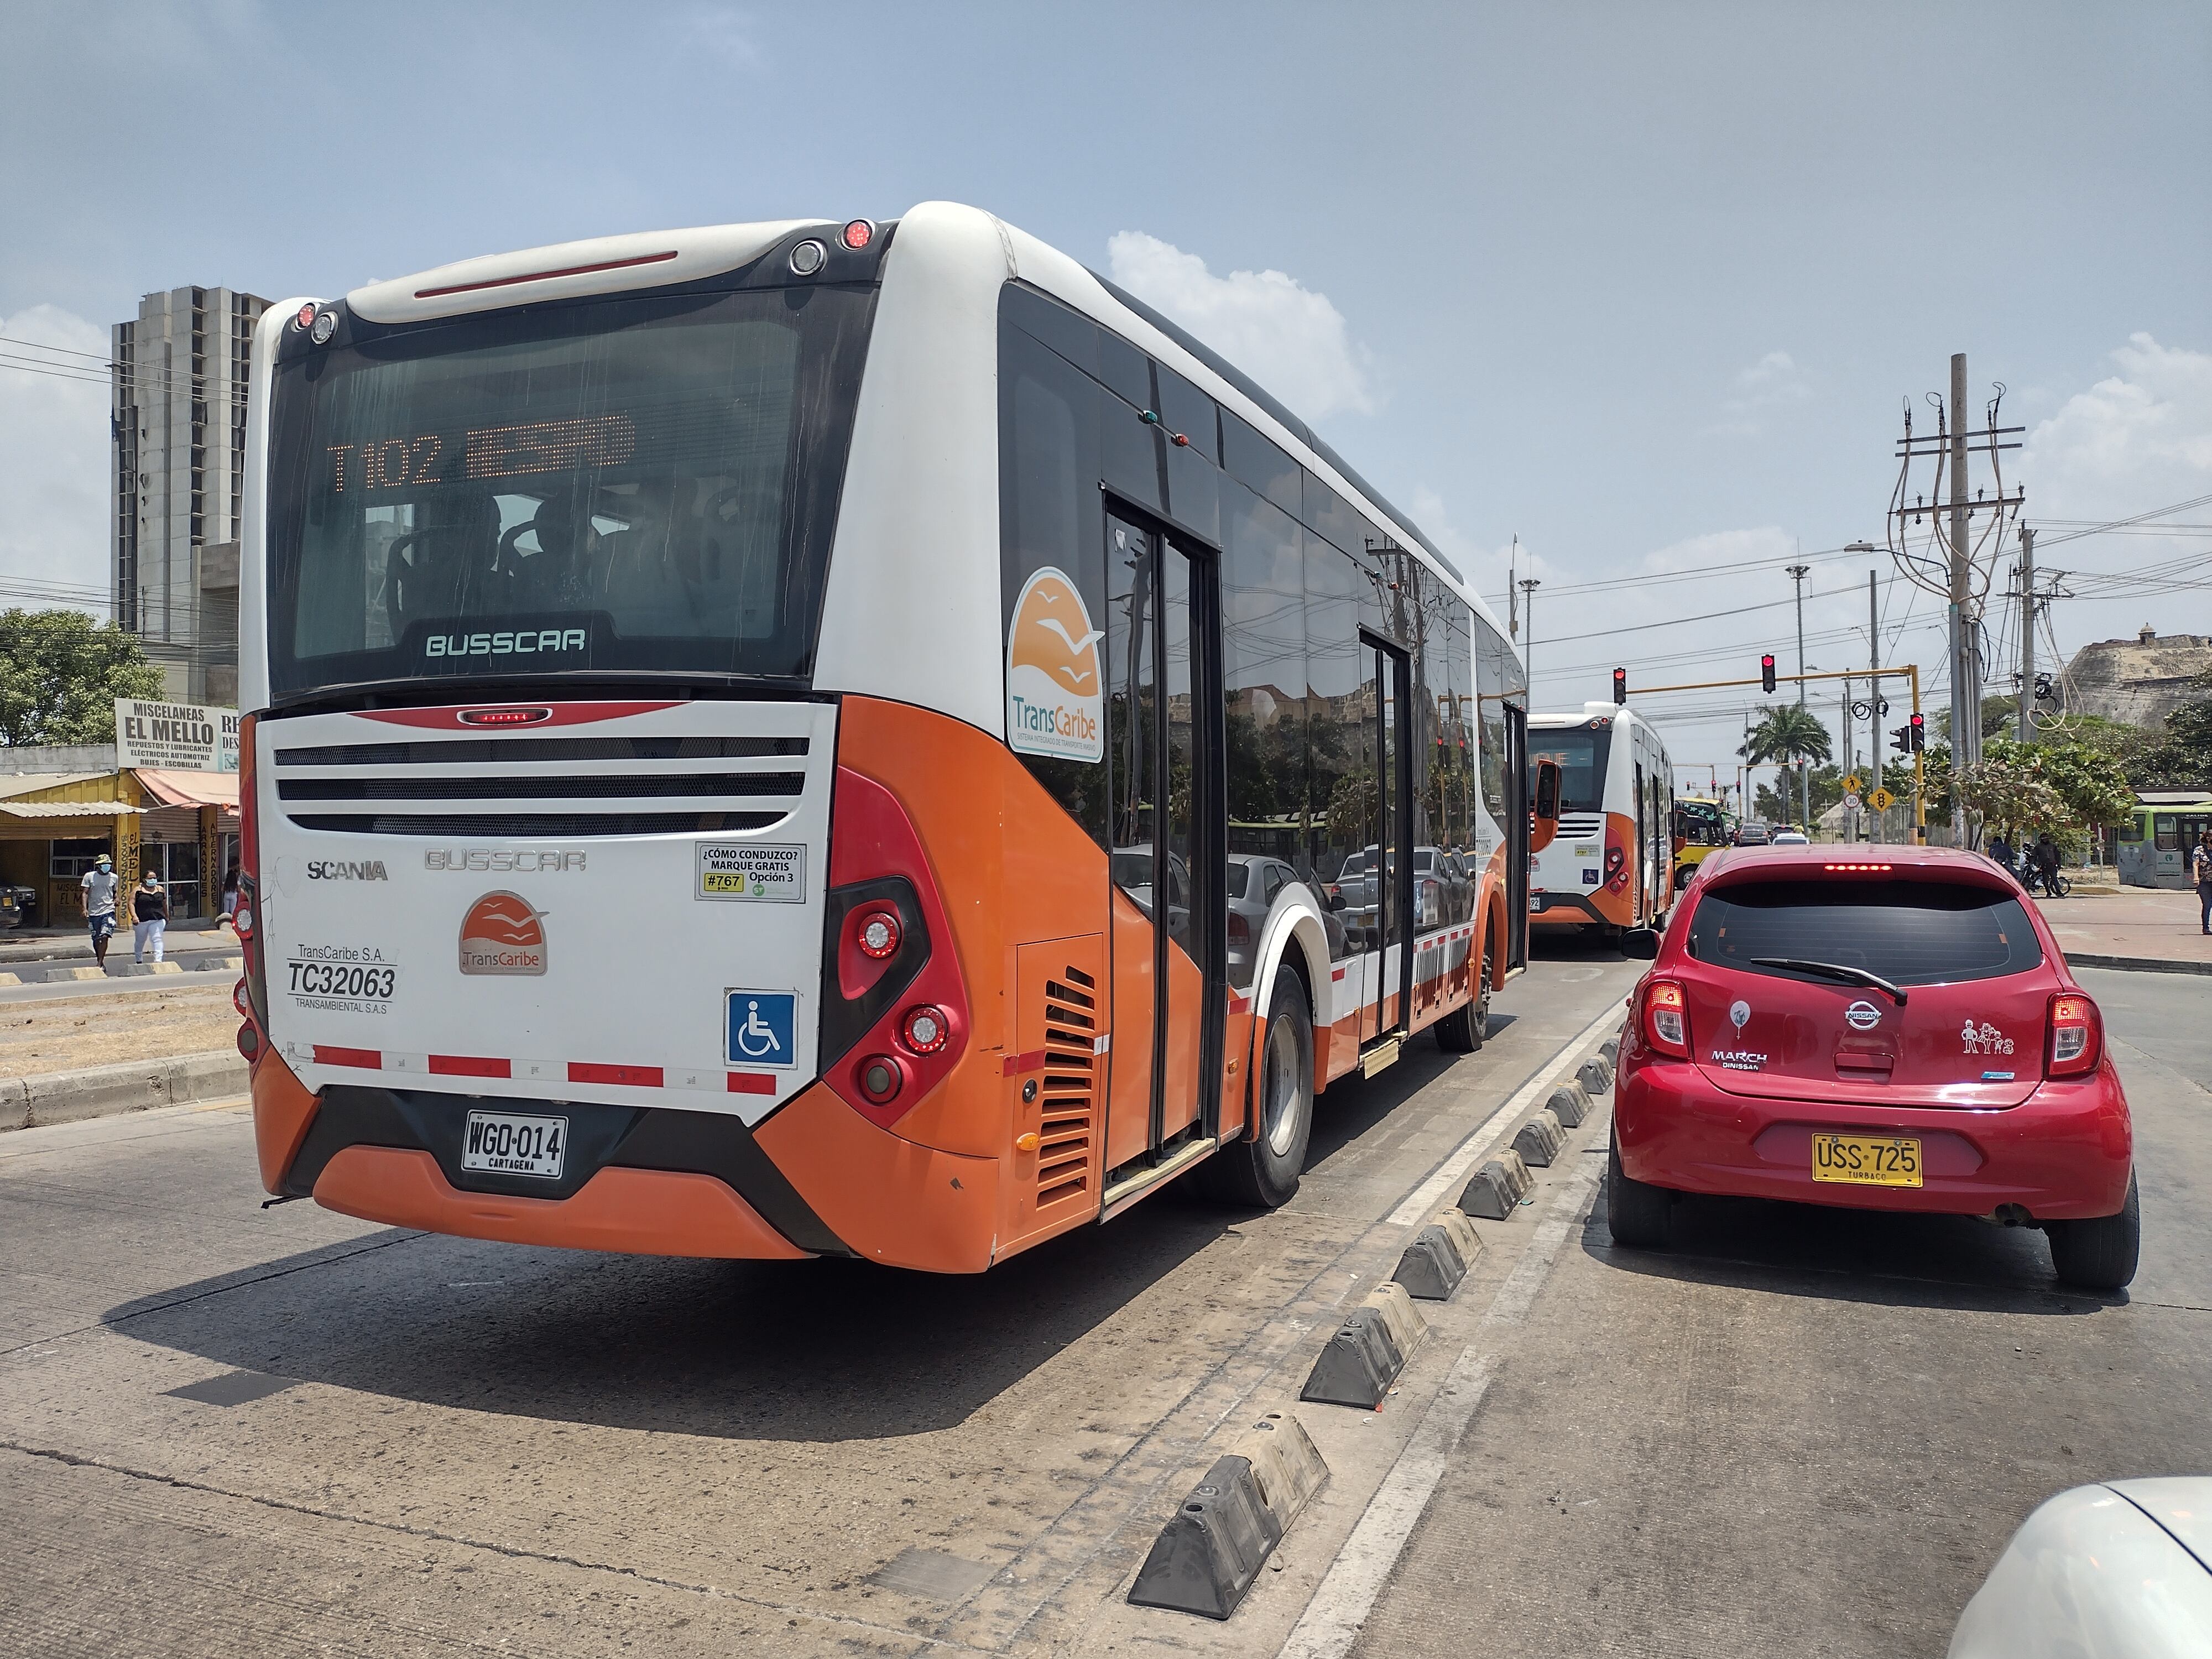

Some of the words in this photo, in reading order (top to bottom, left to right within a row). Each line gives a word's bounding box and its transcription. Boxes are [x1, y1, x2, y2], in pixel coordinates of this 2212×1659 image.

[327, 435, 441, 492] T102
[426, 629, 586, 656] BUSSCAR
[134, 703, 205, 722] MISCELANEAS
[1013, 695, 1095, 741] TransCaribe
[125, 717, 147, 740] EL
[152, 719, 213, 745] MELLO
[127, 741, 165, 749] REPUESTOS
[171, 744, 212, 753] LUBRICANTES
[1017, 732, 1034, 741] SISTEMA
[1034, 735, 1056, 745] INTEGRADO
[1061, 739, 1083, 749] TRANSPORTE
[1083, 743, 1096, 752] MASIVO
[131, 749, 169, 758] ELÉCTRICOS
[170, 752, 210, 761] AUTOMOTRIZ
[165, 760, 202, 769] ESCOBILLAS
[425, 848, 586, 872] BUSSCAR
[703, 848, 737, 860] ¿CÓMO
[739, 849, 797, 860] CONDUZCO?
[307, 860, 388, 881] SCANIA
[711, 860, 753, 870] MARQUE
[755, 862, 789, 871] GRATIS
[708, 875, 740, 886] #767
[749, 872, 785, 883] Opción
[787, 873, 794, 882] 3
[298, 944, 358, 961] TransCaribe
[362, 947, 385, 962] S.A.
[463, 951, 539, 966] TransCaribe
[289, 962, 395, 998] TC32063
[295, 998, 364, 1013] TRANSAMBIENTAL
[366, 1004, 387, 1014] S.A.S
[1711, 1050, 1767, 1063] MARCH
[1723, 1062, 1759, 1071] DINISSAN
[488, 1157, 534, 1171] CARTAGENA
[1848, 1171, 1887, 1181] TURBACO
